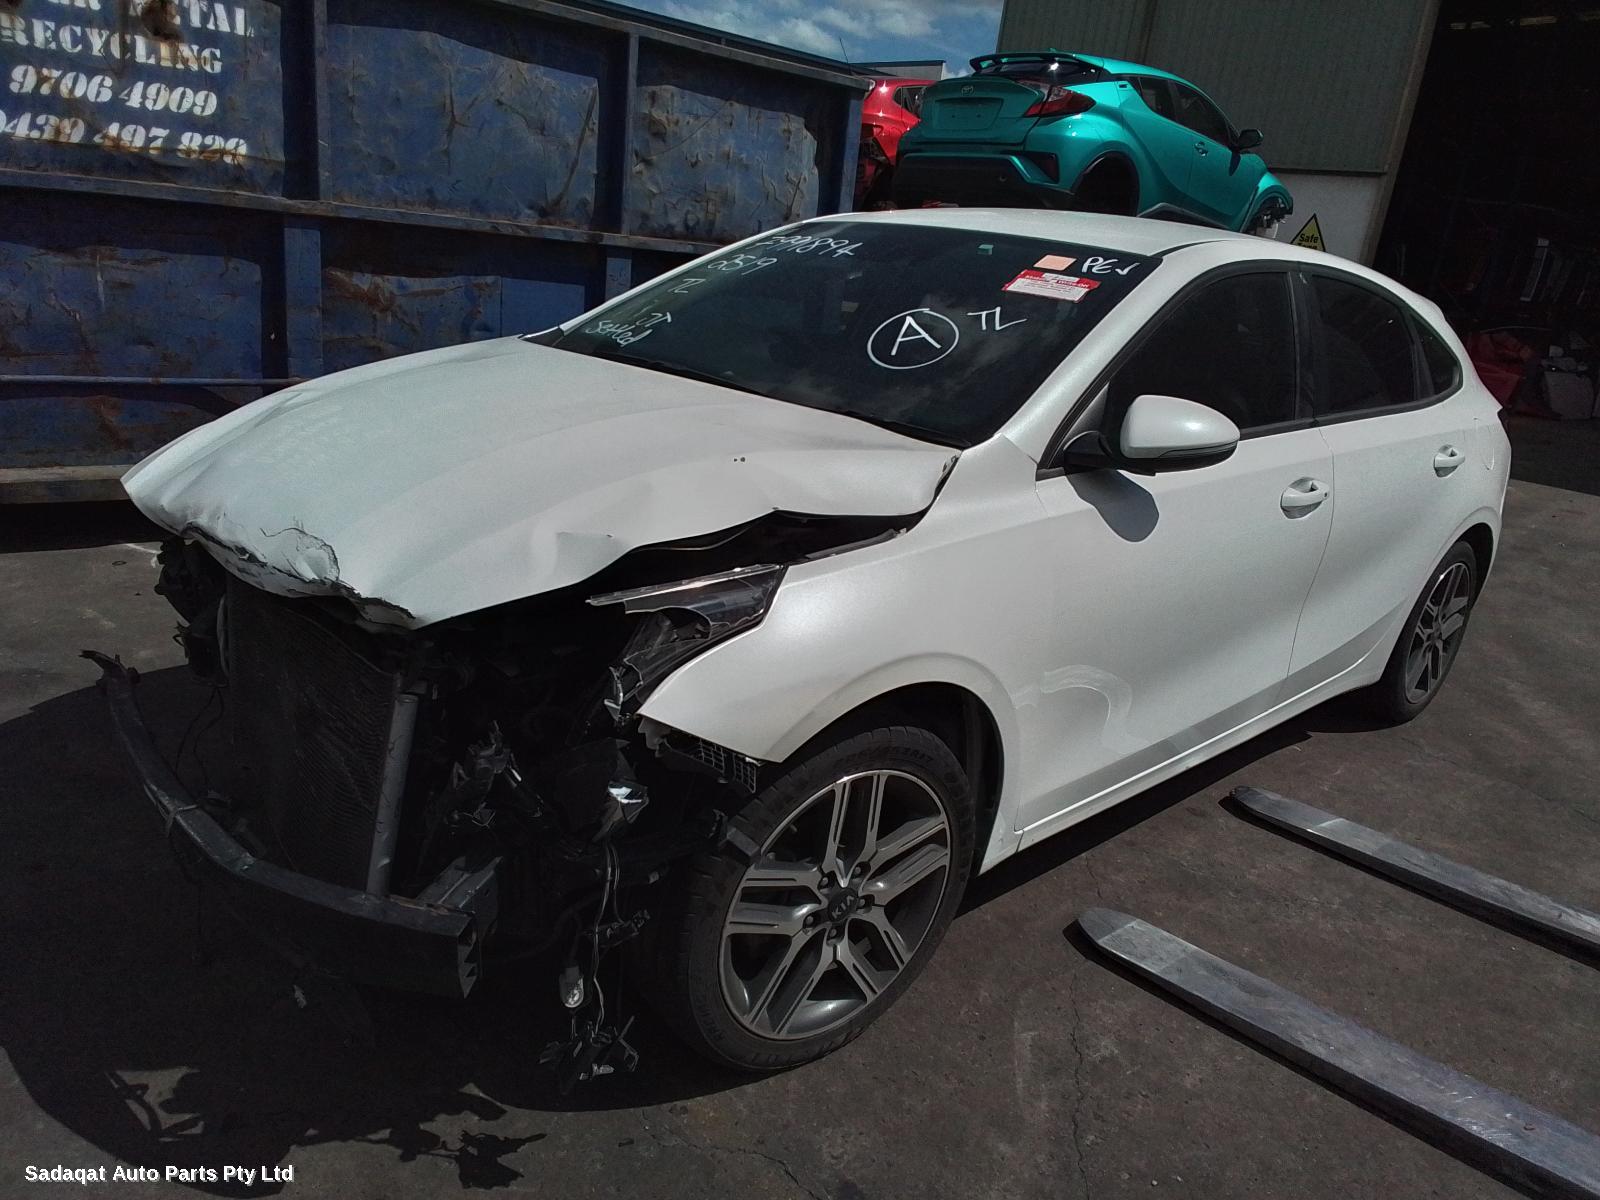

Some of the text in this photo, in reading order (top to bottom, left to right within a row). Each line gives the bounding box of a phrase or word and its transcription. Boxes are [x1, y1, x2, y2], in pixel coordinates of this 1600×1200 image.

[0, 12, 223, 74] RECYCLING
[9, 64, 218, 117] 9706 4909
[1299, 233, 1319, 244] Safe
[890, 315, 943, 356] A
